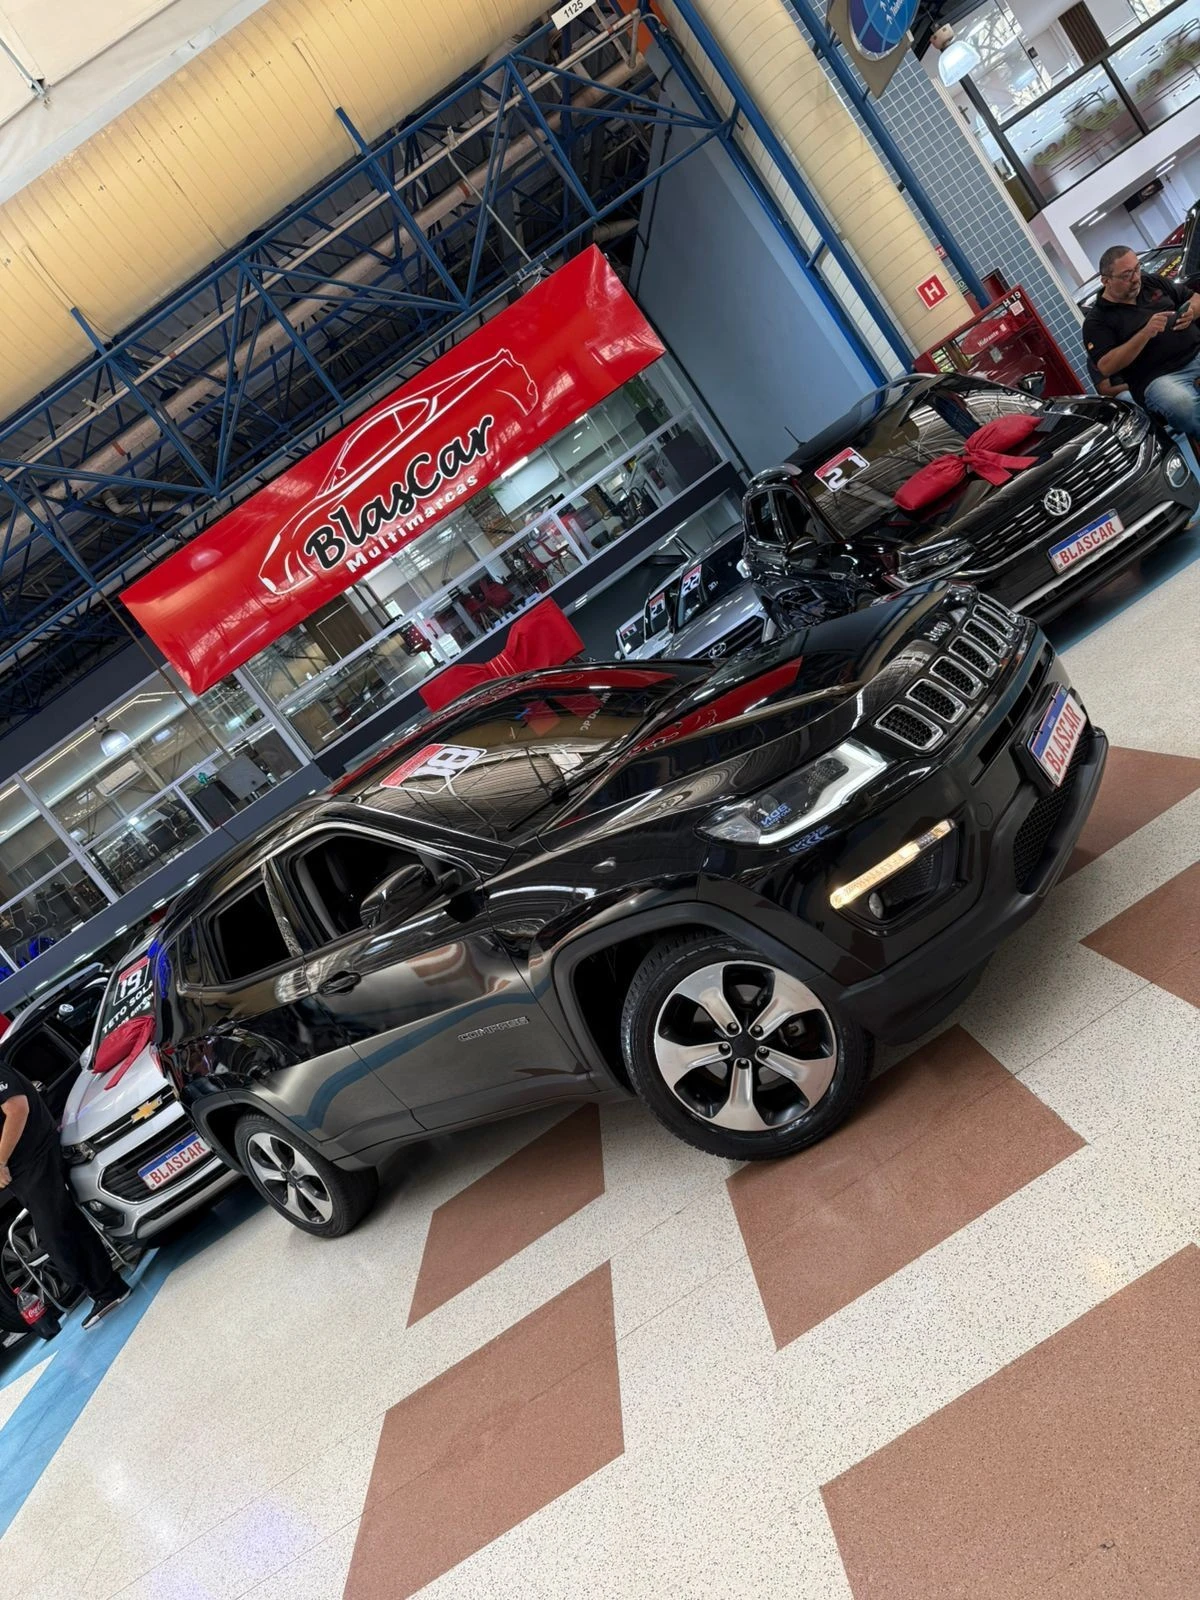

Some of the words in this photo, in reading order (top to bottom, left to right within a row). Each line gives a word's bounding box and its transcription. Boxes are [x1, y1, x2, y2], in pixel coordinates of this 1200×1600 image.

[563, 0, 584, 18] 1125
[924, 282, 941, 301] H
[305, 415, 494, 570] BlasCar
[346, 475, 478, 574] Multimarcas
[1059, 521, 1117, 565] BLASCAR
[923, 621, 952, 641] Jeep
[1045, 702, 1081, 774] BLASCAR
[408, 747, 481, 778] 18
[120, 969, 142, 998] 19
[102, 1005, 128, 1034] TETO
[129, 980, 153, 1007] SOLA
[458, 1016, 529, 1041] COMPASS
[149, 1141, 206, 1184] BLASCAR
